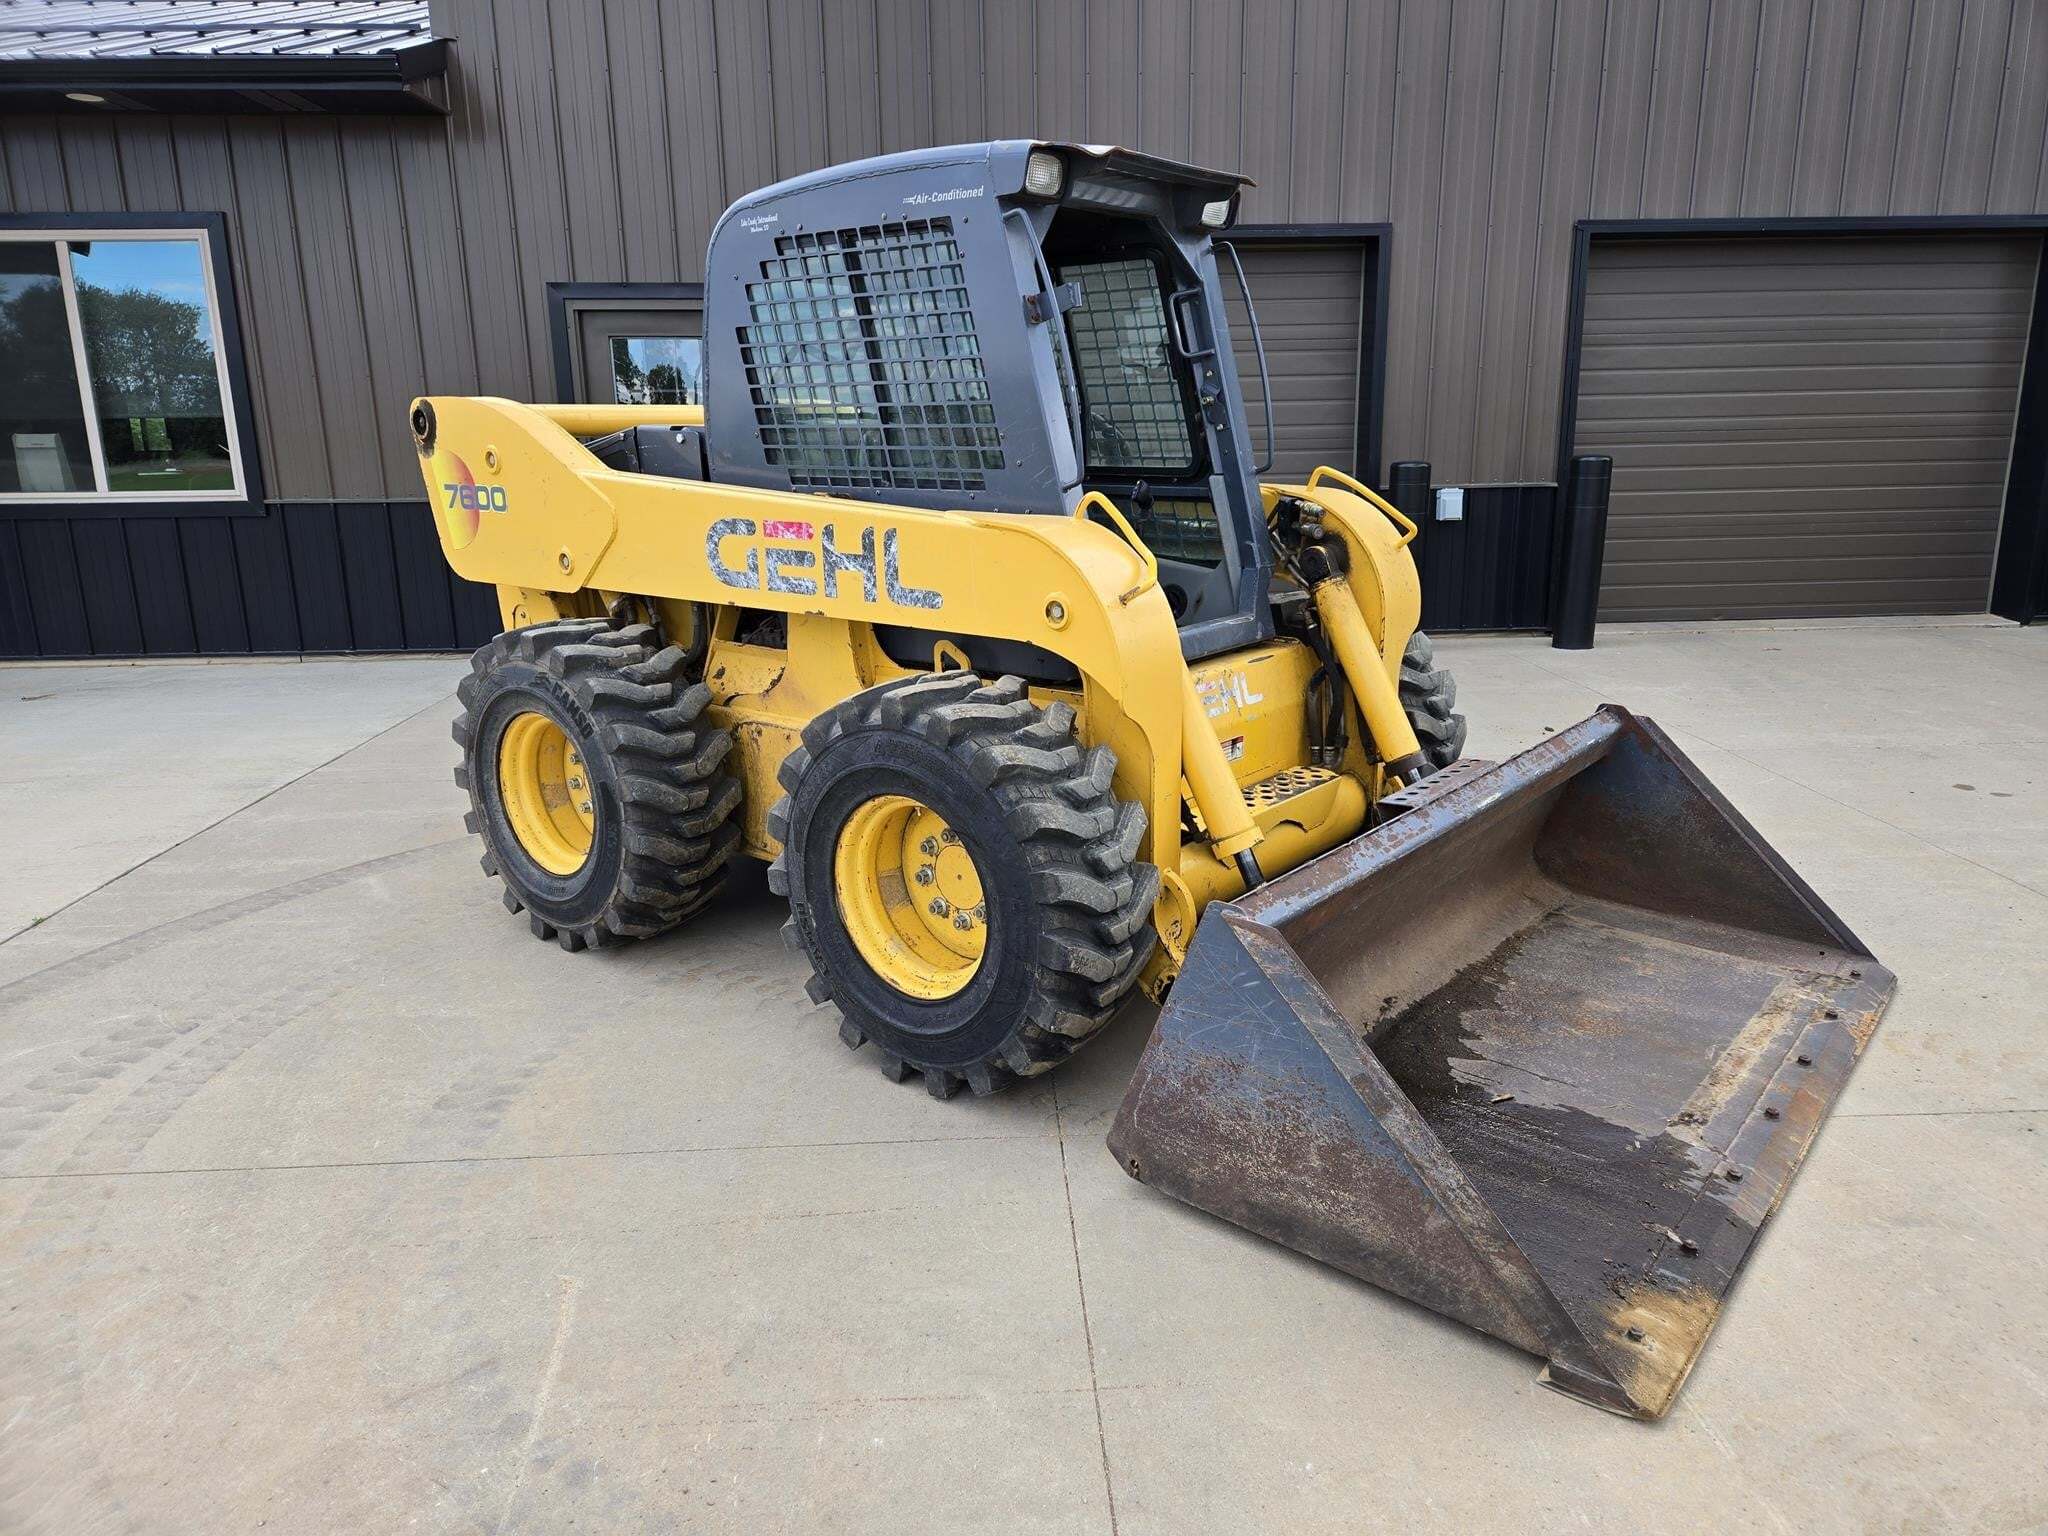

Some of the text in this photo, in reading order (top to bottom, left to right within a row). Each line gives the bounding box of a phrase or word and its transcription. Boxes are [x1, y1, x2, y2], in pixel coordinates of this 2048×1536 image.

[916, 185, 984, 204] Air-Conditioned
[443, 484, 507, 512] 7600
[706, 518, 943, 610] GEHL
[1196, 671, 1264, 718] EHL
